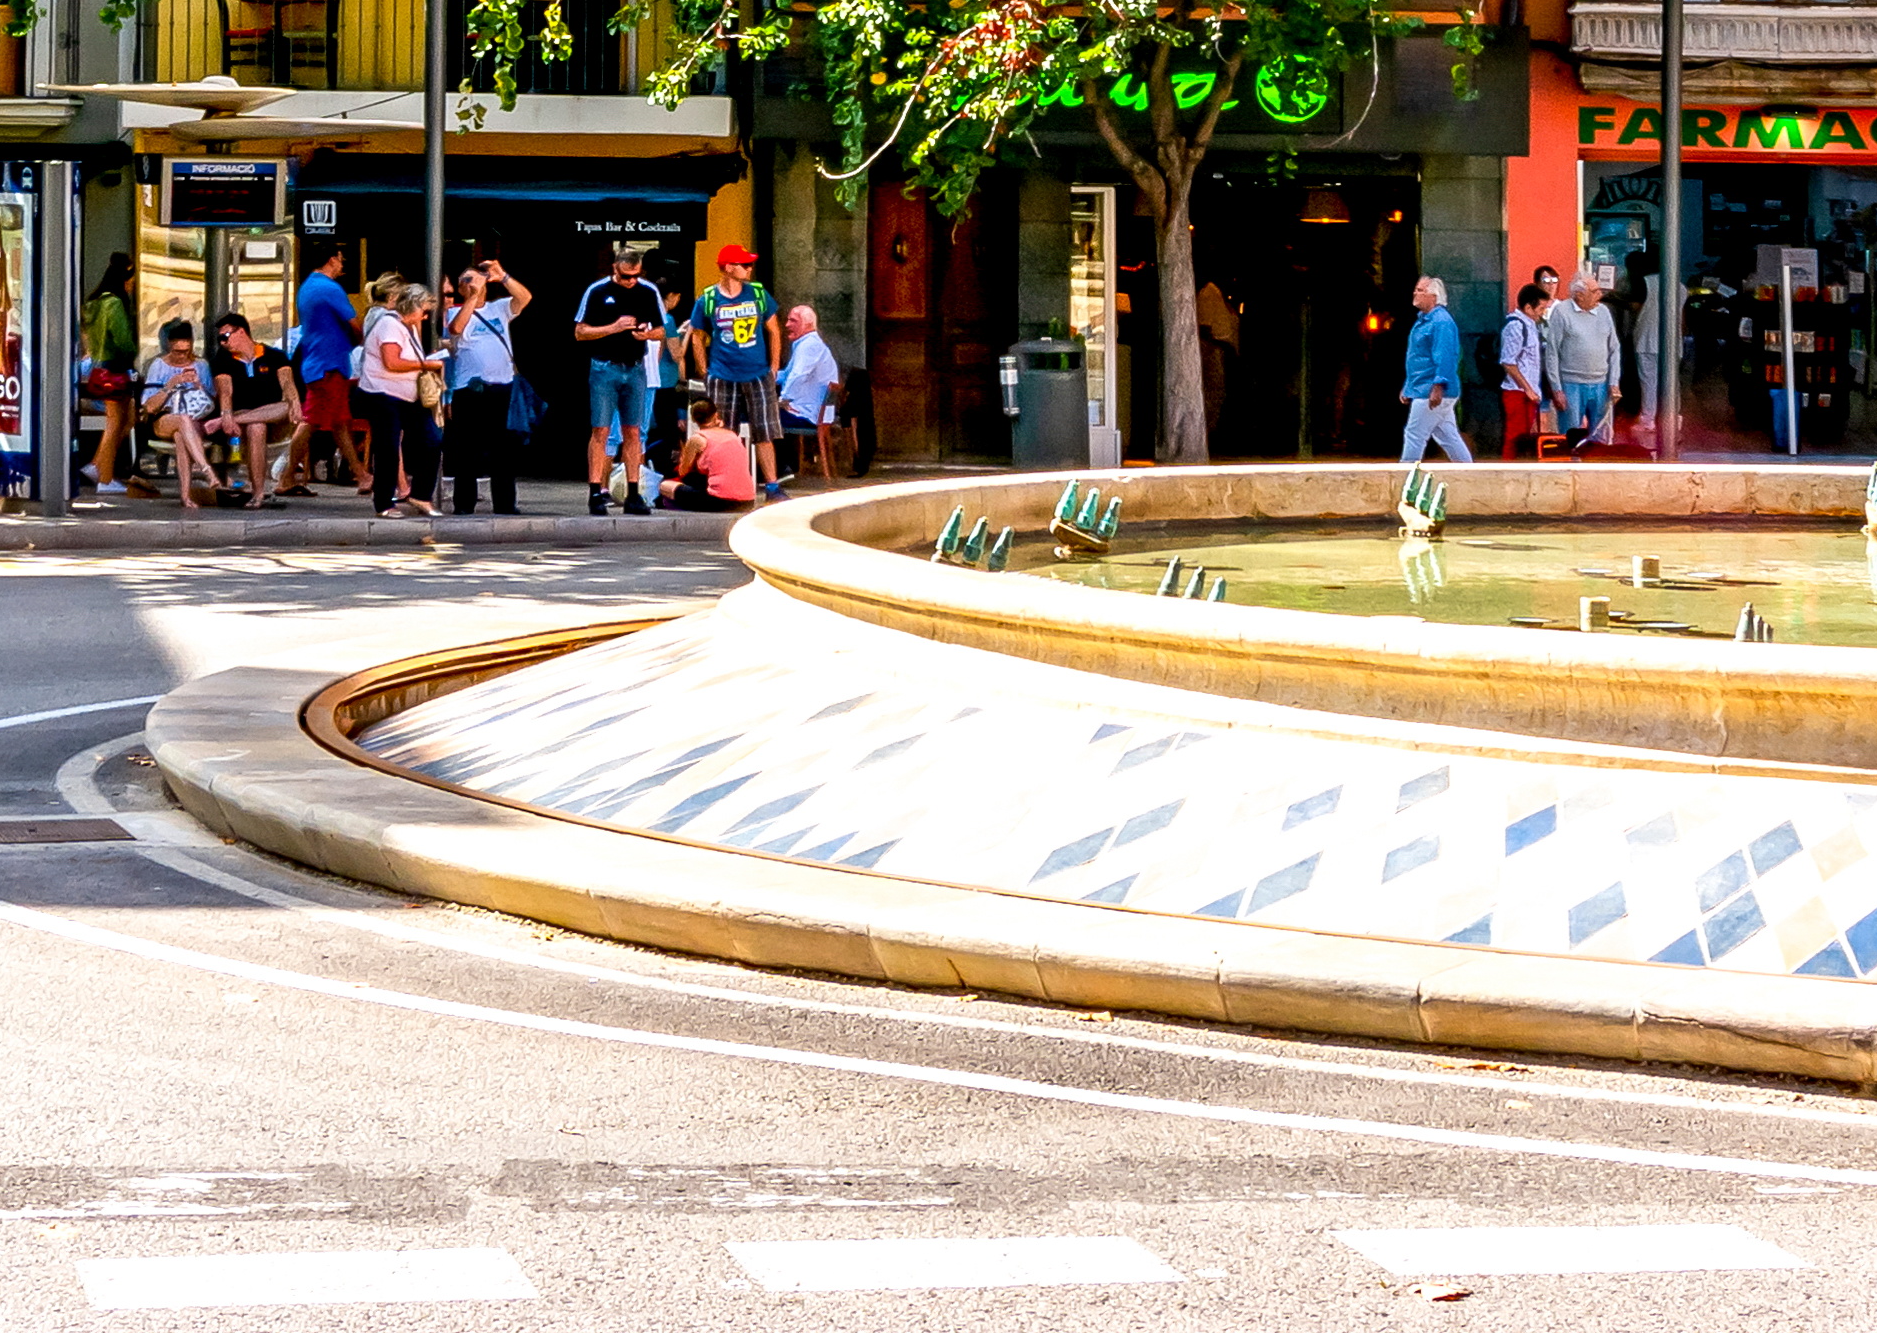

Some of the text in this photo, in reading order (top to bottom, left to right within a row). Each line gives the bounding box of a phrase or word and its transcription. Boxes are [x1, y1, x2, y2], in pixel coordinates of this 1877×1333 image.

[605, 221, 623, 232] Bar
[624, 220, 637, 232] &
[638, 221, 682, 232] Cocktails
[733, 316, 758, 344] 67
